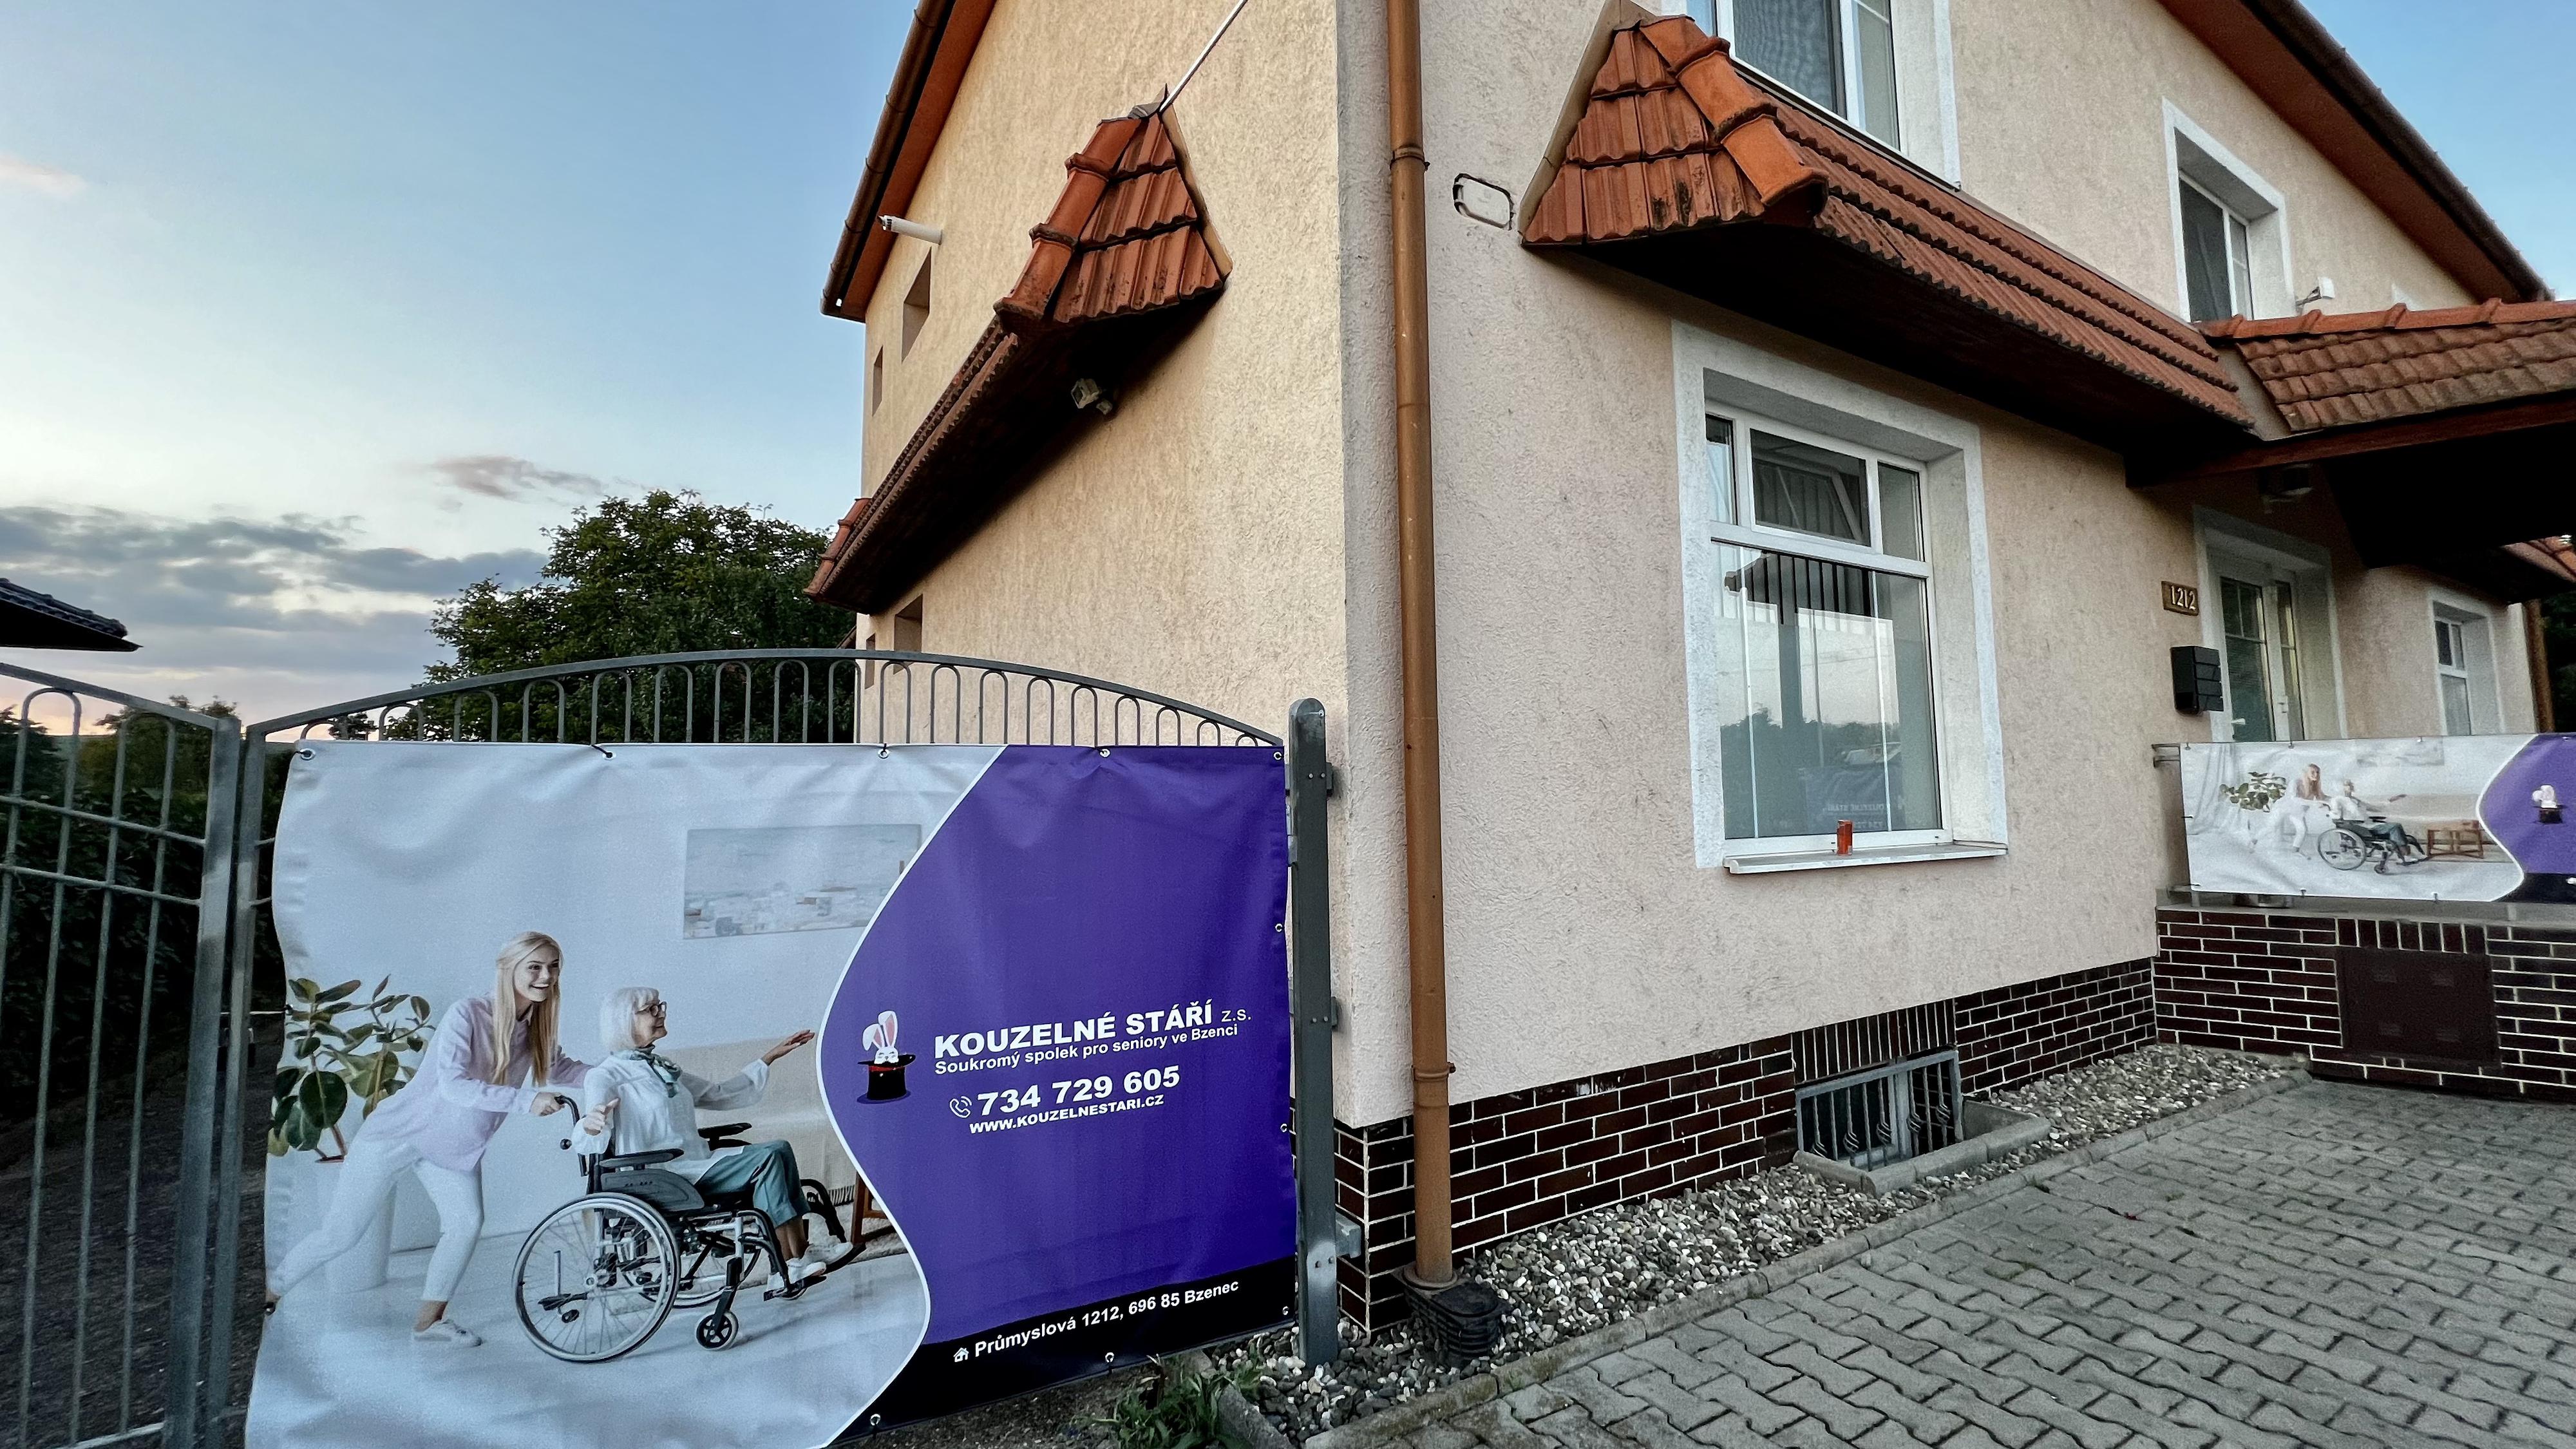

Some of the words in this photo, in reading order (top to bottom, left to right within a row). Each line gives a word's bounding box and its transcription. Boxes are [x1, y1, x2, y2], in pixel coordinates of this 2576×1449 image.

[2171, 585, 2196, 610] 1212
[934, 1011, 1116, 1059] KOUZELNÉ
[1125, 998, 1213, 1035] STÁŘÍ
[934, 1051, 1021, 1075] Soukromý
[1025, 1045, 1079, 1065] spolek
[1083, 1043, 1108, 1059] pro
[1112, 1035, 1168, 1052] seniory
[1171, 1033, 1188, 1044] ve
[1191, 1023, 1238, 1041] Bzenci
[969, 1094, 1164, 1134] WWW.KOUZELNESTARI.CZ
[977, 1084, 1041, 1116] 734
[1052, 1075, 1113, 1104] 729
[1123, 1065, 1180, 1094] 605
[975, 1316, 1076, 1358] Průmyslová
[1082, 1306, 1124, 1327] 1212,
[1128, 1296, 1157, 1315] 696
[1160, 1293, 1180, 1308] 85
[1184, 1281, 1239, 1304] Bzenec
